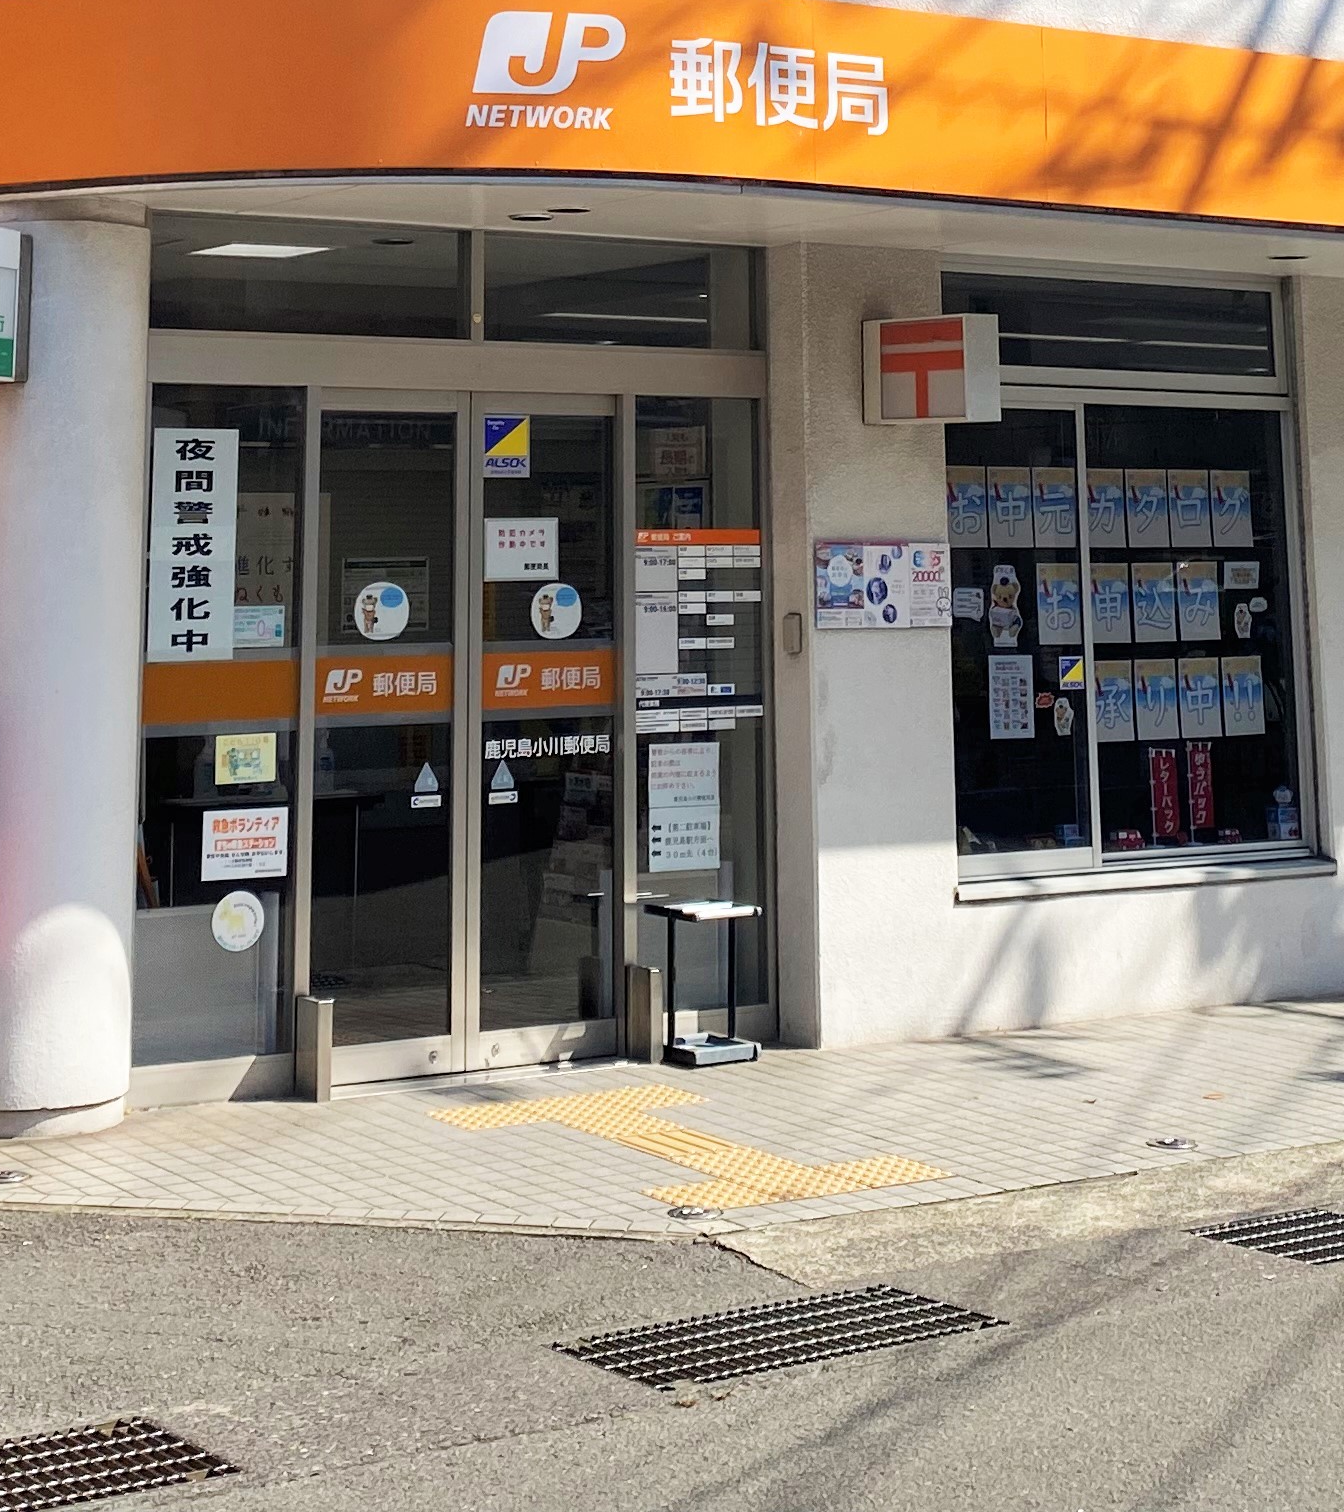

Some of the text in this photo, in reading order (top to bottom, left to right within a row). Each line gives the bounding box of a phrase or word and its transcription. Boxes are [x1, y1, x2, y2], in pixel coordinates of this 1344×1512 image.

[669, 37, 890, 136] 郵便局
[465, 103, 615, 131] NETWORK
[485, 457, 527, 468] ALSOK
[950, 489, 1250, 537] お中元カタログ
[169, 438, 216, 653] 夜間警戒強化中
[1046, 586, 1215, 632] お申込み
[372, 672, 437, 697] 郵便局
[541, 666, 601, 691] 郵便局
[484, 734, 610, 759] 鹿児島小川郵便局
[1159, 757, 1175, 834] レターパック
[212, 816, 280, 834] 救急ボランティア
